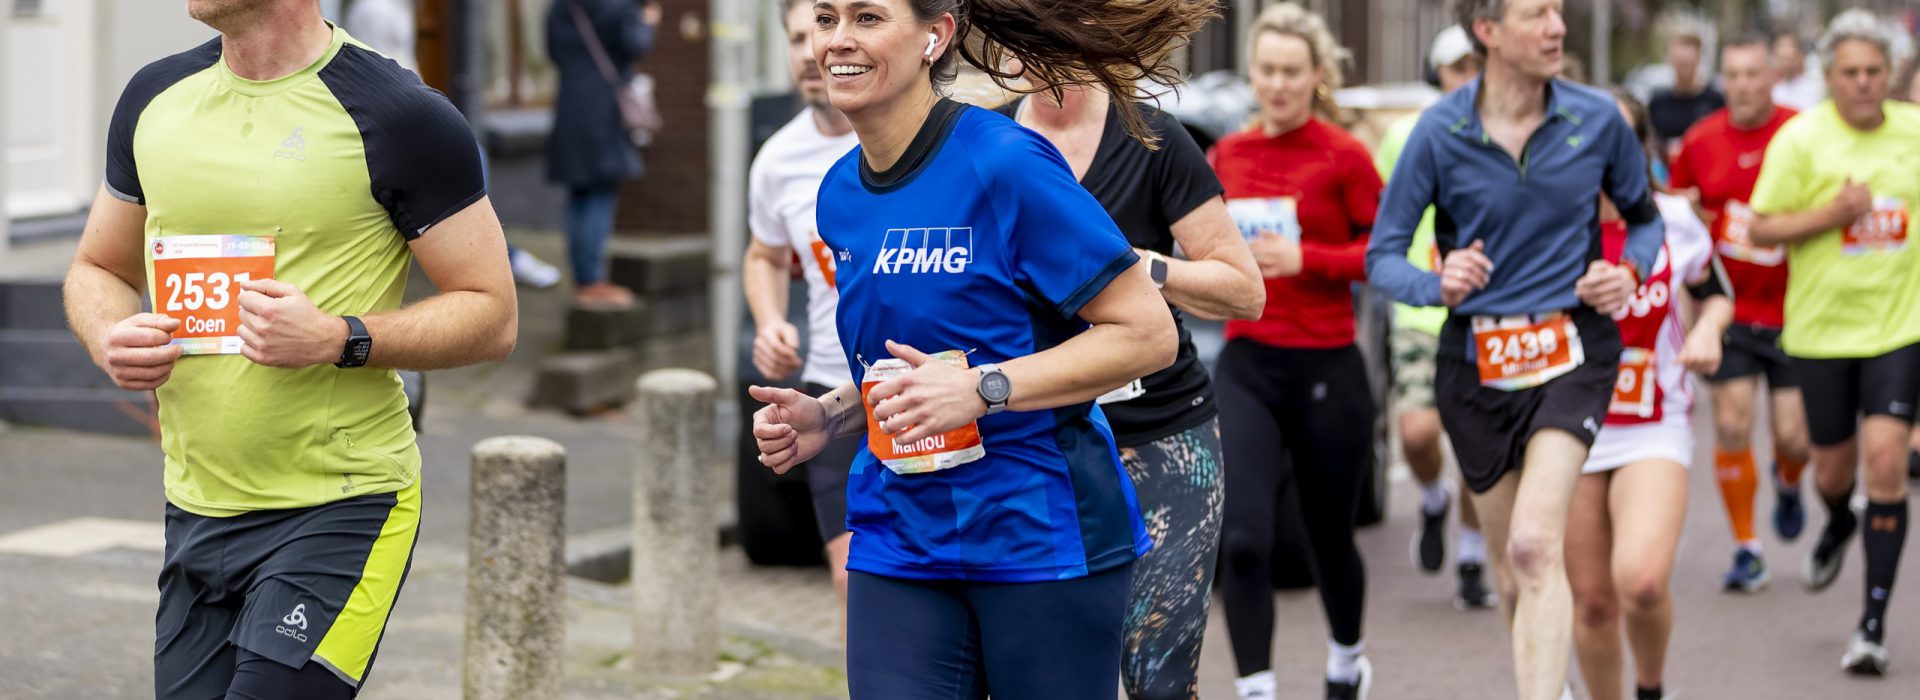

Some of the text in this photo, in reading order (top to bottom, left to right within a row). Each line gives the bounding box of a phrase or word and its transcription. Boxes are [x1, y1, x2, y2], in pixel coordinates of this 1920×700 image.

[872, 246, 968, 274] KPMG
[165, 271, 250, 311] 253
[185, 315, 226, 333] Coen
[275, 625, 308, 643] odlo
